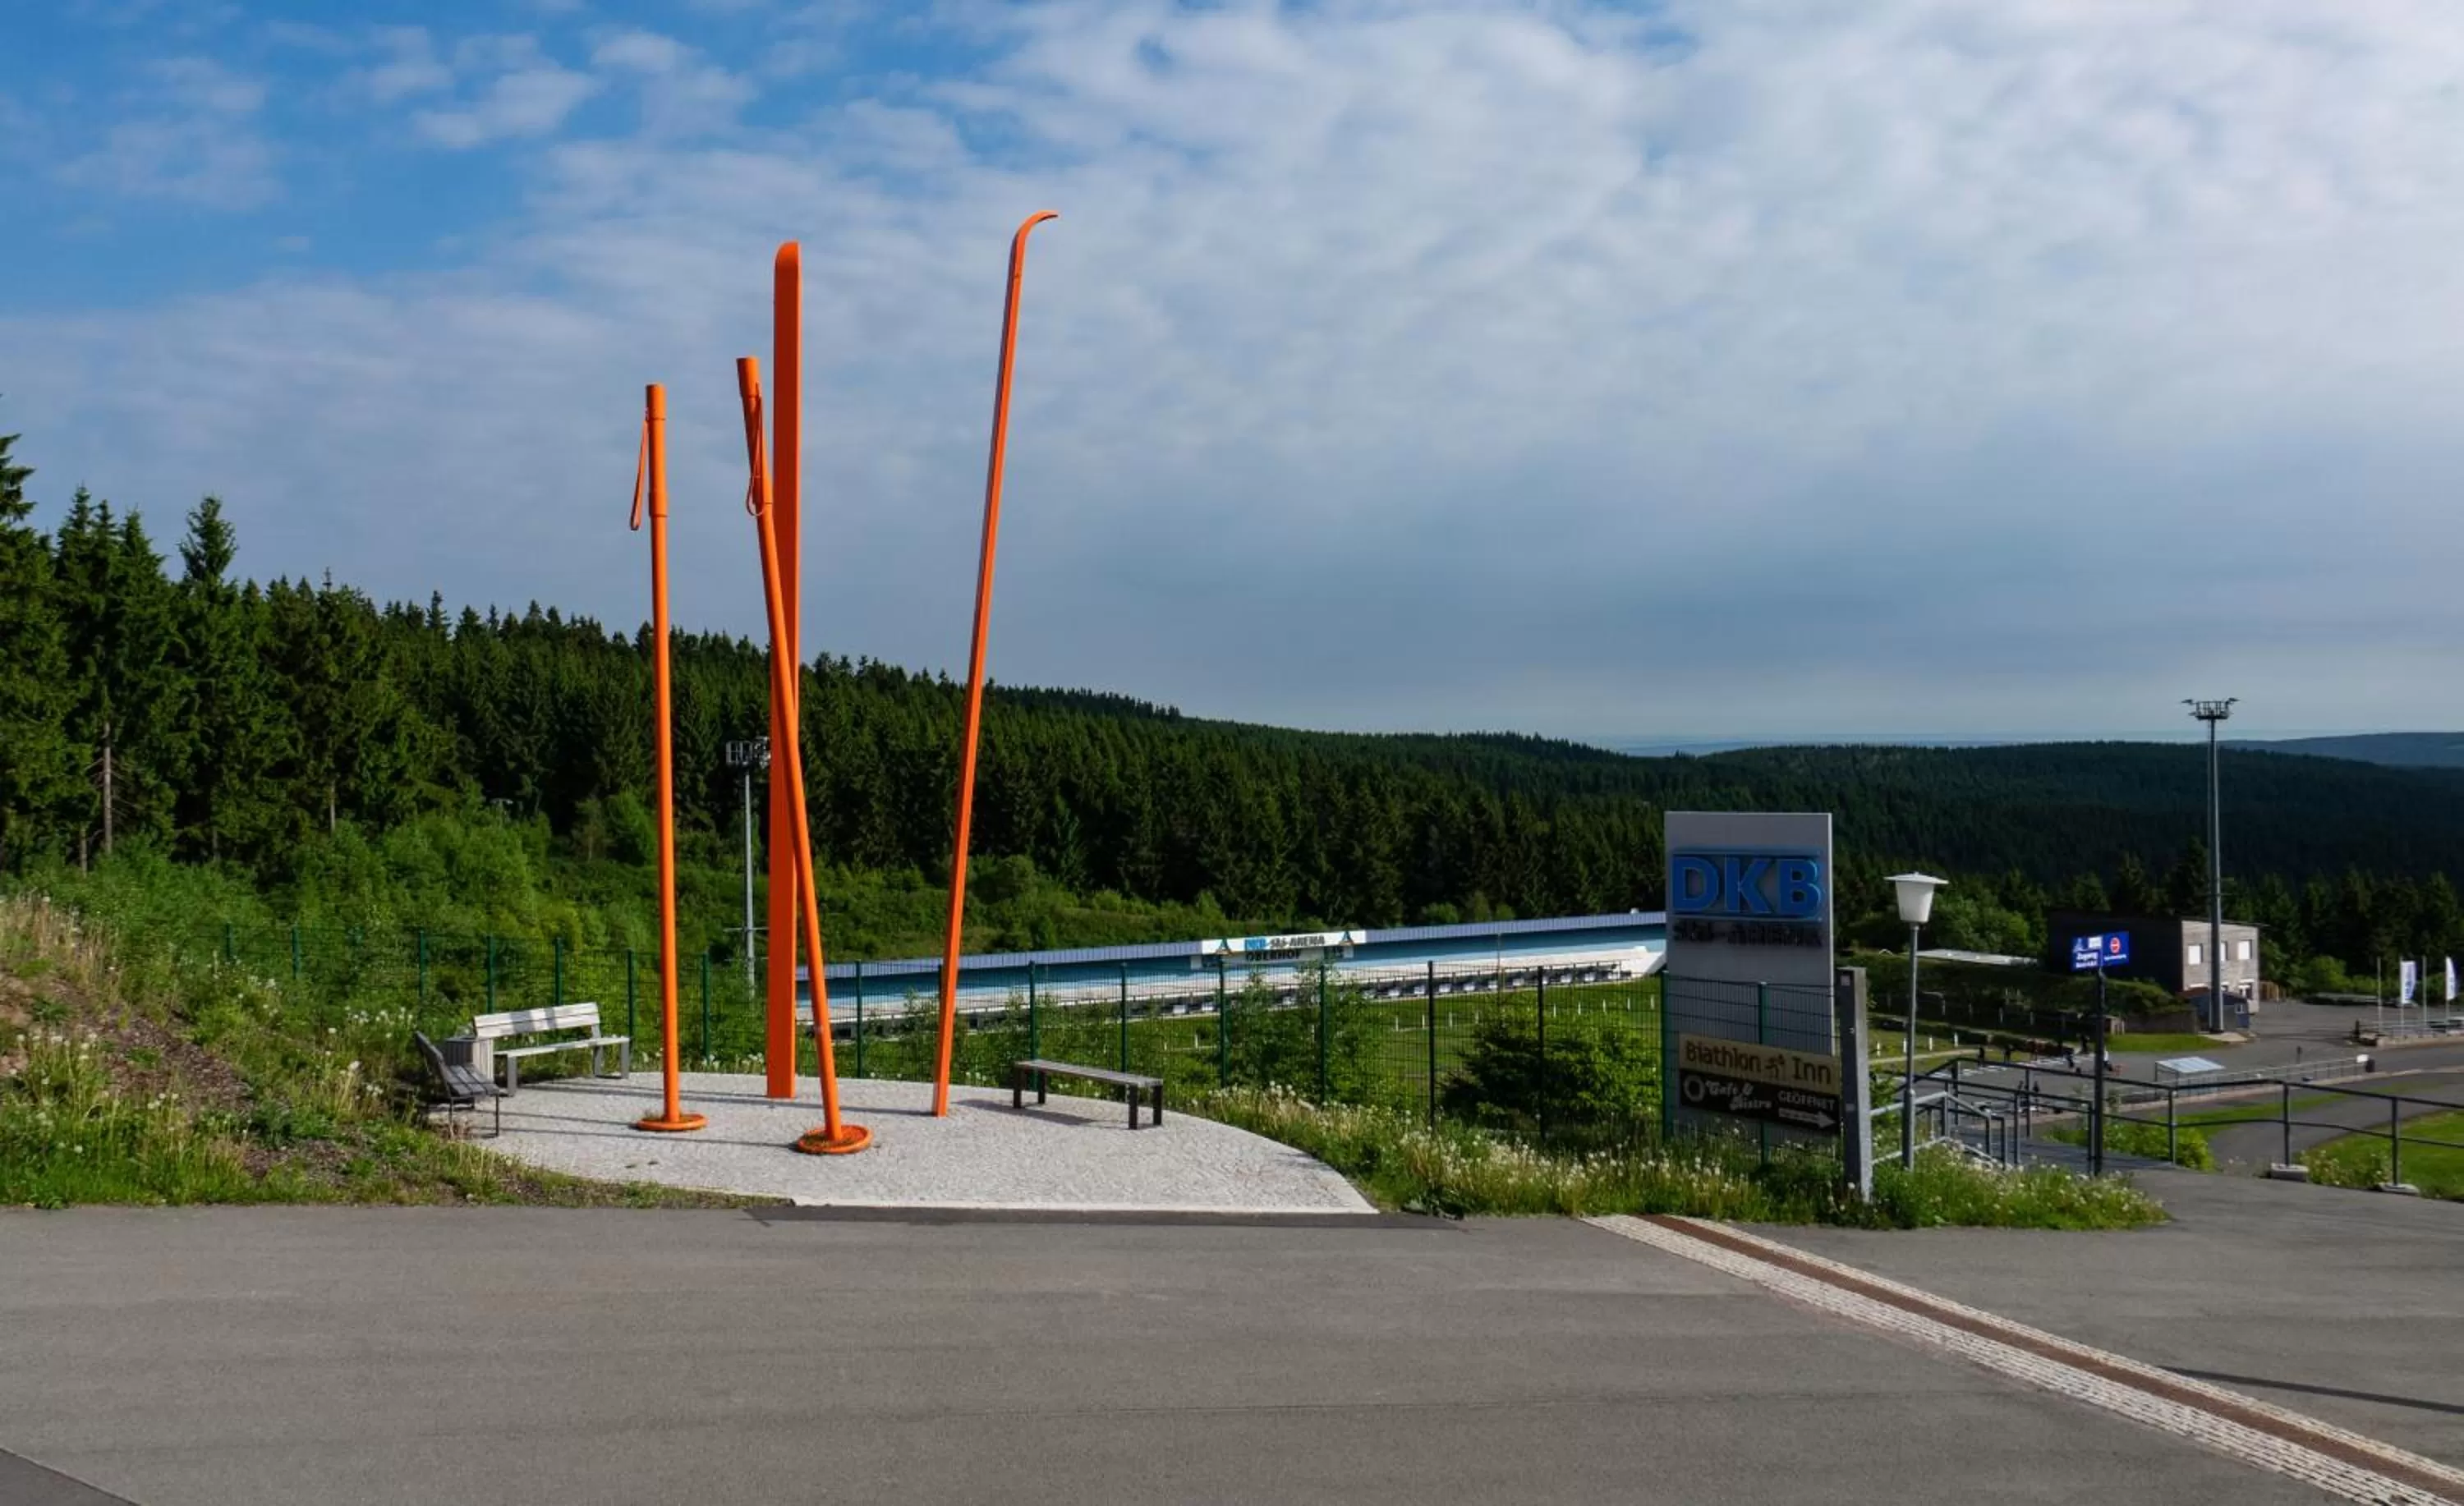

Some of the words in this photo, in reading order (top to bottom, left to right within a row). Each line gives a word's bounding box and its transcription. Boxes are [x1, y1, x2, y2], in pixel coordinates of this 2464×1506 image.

[1672, 856, 1821, 917] DKB
[1685, 1040, 1761, 1072] Biathlon
[1791, 1056, 1832, 1085] Inn
